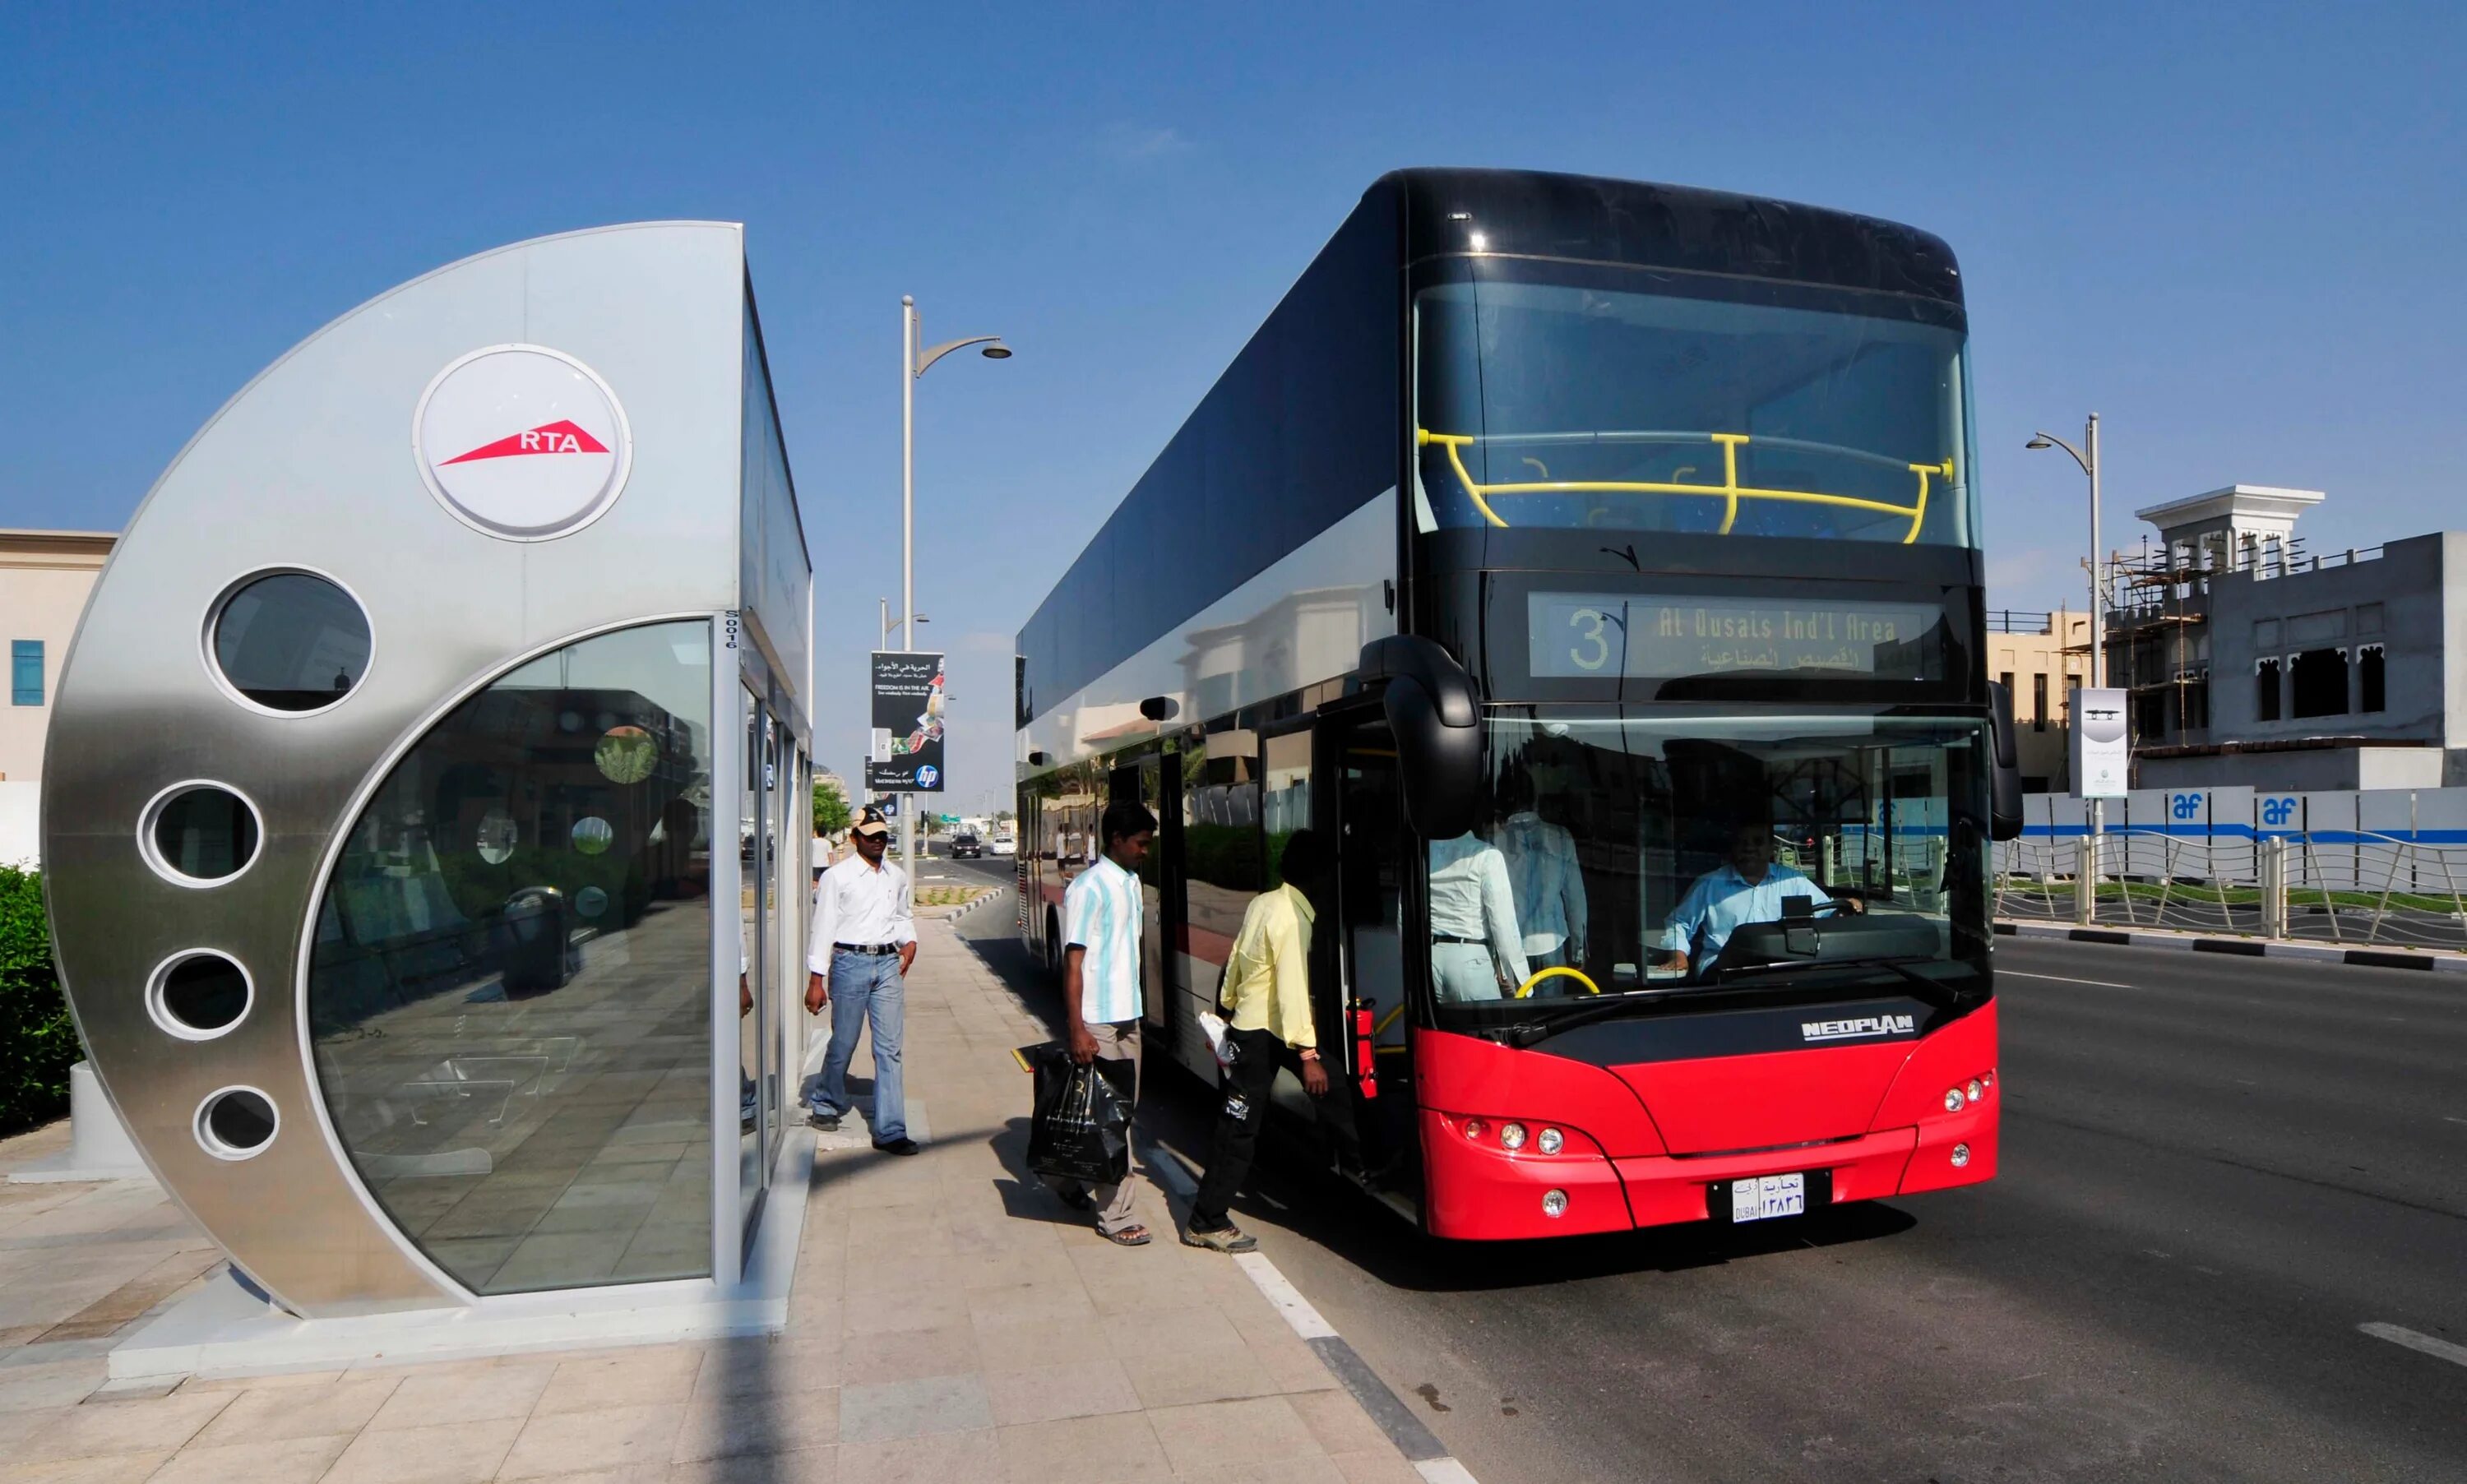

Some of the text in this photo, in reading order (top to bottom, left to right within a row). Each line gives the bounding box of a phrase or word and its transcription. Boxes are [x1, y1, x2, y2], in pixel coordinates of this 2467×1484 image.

[521, 431, 582, 453] RTA
[725, 610, 738, 649] S0016
[1659, 607, 1895, 641] Al Qusais Ind'l Area
[1570, 608, 1608, 670] 3
[918, 765, 937, 788] hp
[1802, 1015, 1914, 1040] NEOPLAN
[1734, 1179, 1757, 1195] دبي
[1736, 1206, 1757, 1219] DUBAI
[1762, 1195, 1803, 1215] ١٣٨٣٦
